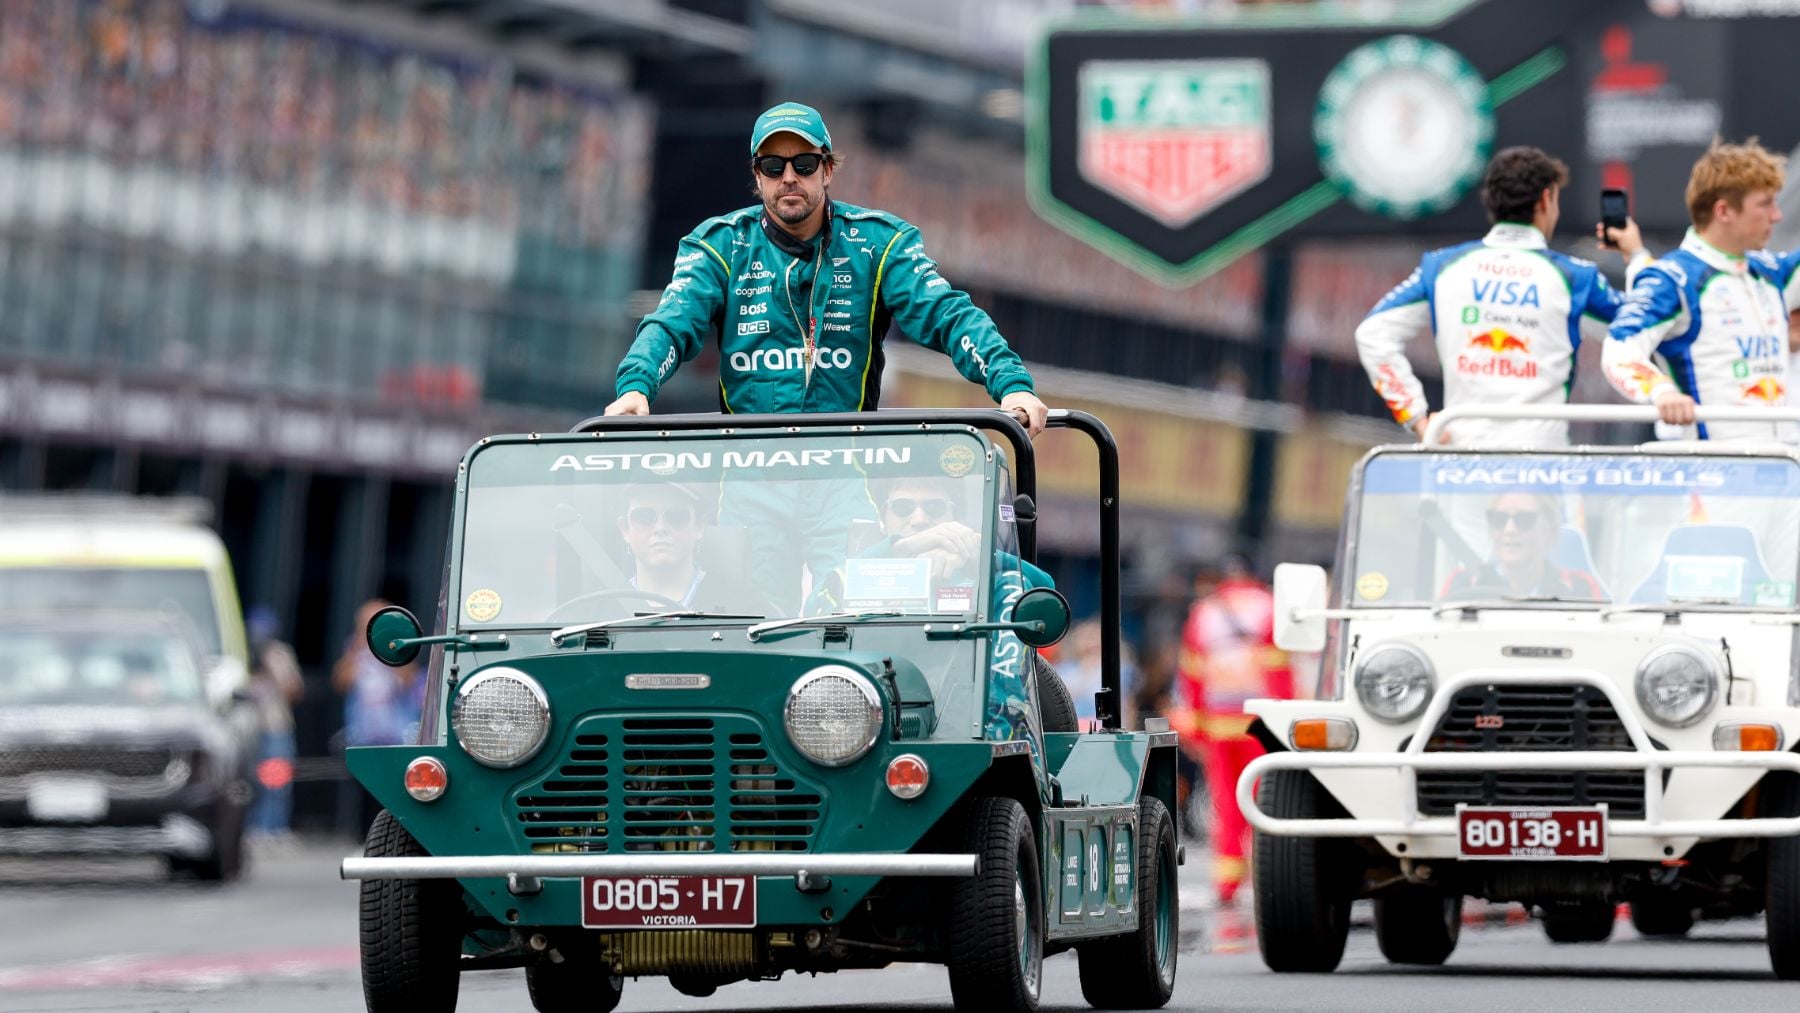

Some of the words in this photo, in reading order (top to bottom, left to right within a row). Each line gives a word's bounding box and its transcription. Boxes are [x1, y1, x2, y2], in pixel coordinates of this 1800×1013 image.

[1093, 71, 1254, 124] TAG
[738, 270, 776, 281] MAADEN
[1478, 263, 1533, 277] HUGO
[1471, 277, 1541, 308] VISA
[739, 302, 768, 316] BOSS
[739, 321, 769, 335] JCB
[730, 347, 852, 371] aramco
[1458, 355, 1495, 375] Red
[1499, 358, 1537, 378] Bull
[550, 452, 712, 471] ASTON
[722, 447, 911, 468] MARTIN
[1436, 468, 1588, 485] RACING
[1595, 469, 1725, 486] BULLS
[1090, 843, 1098, 892] 18
[642, 915, 697, 925] VICTORIA
